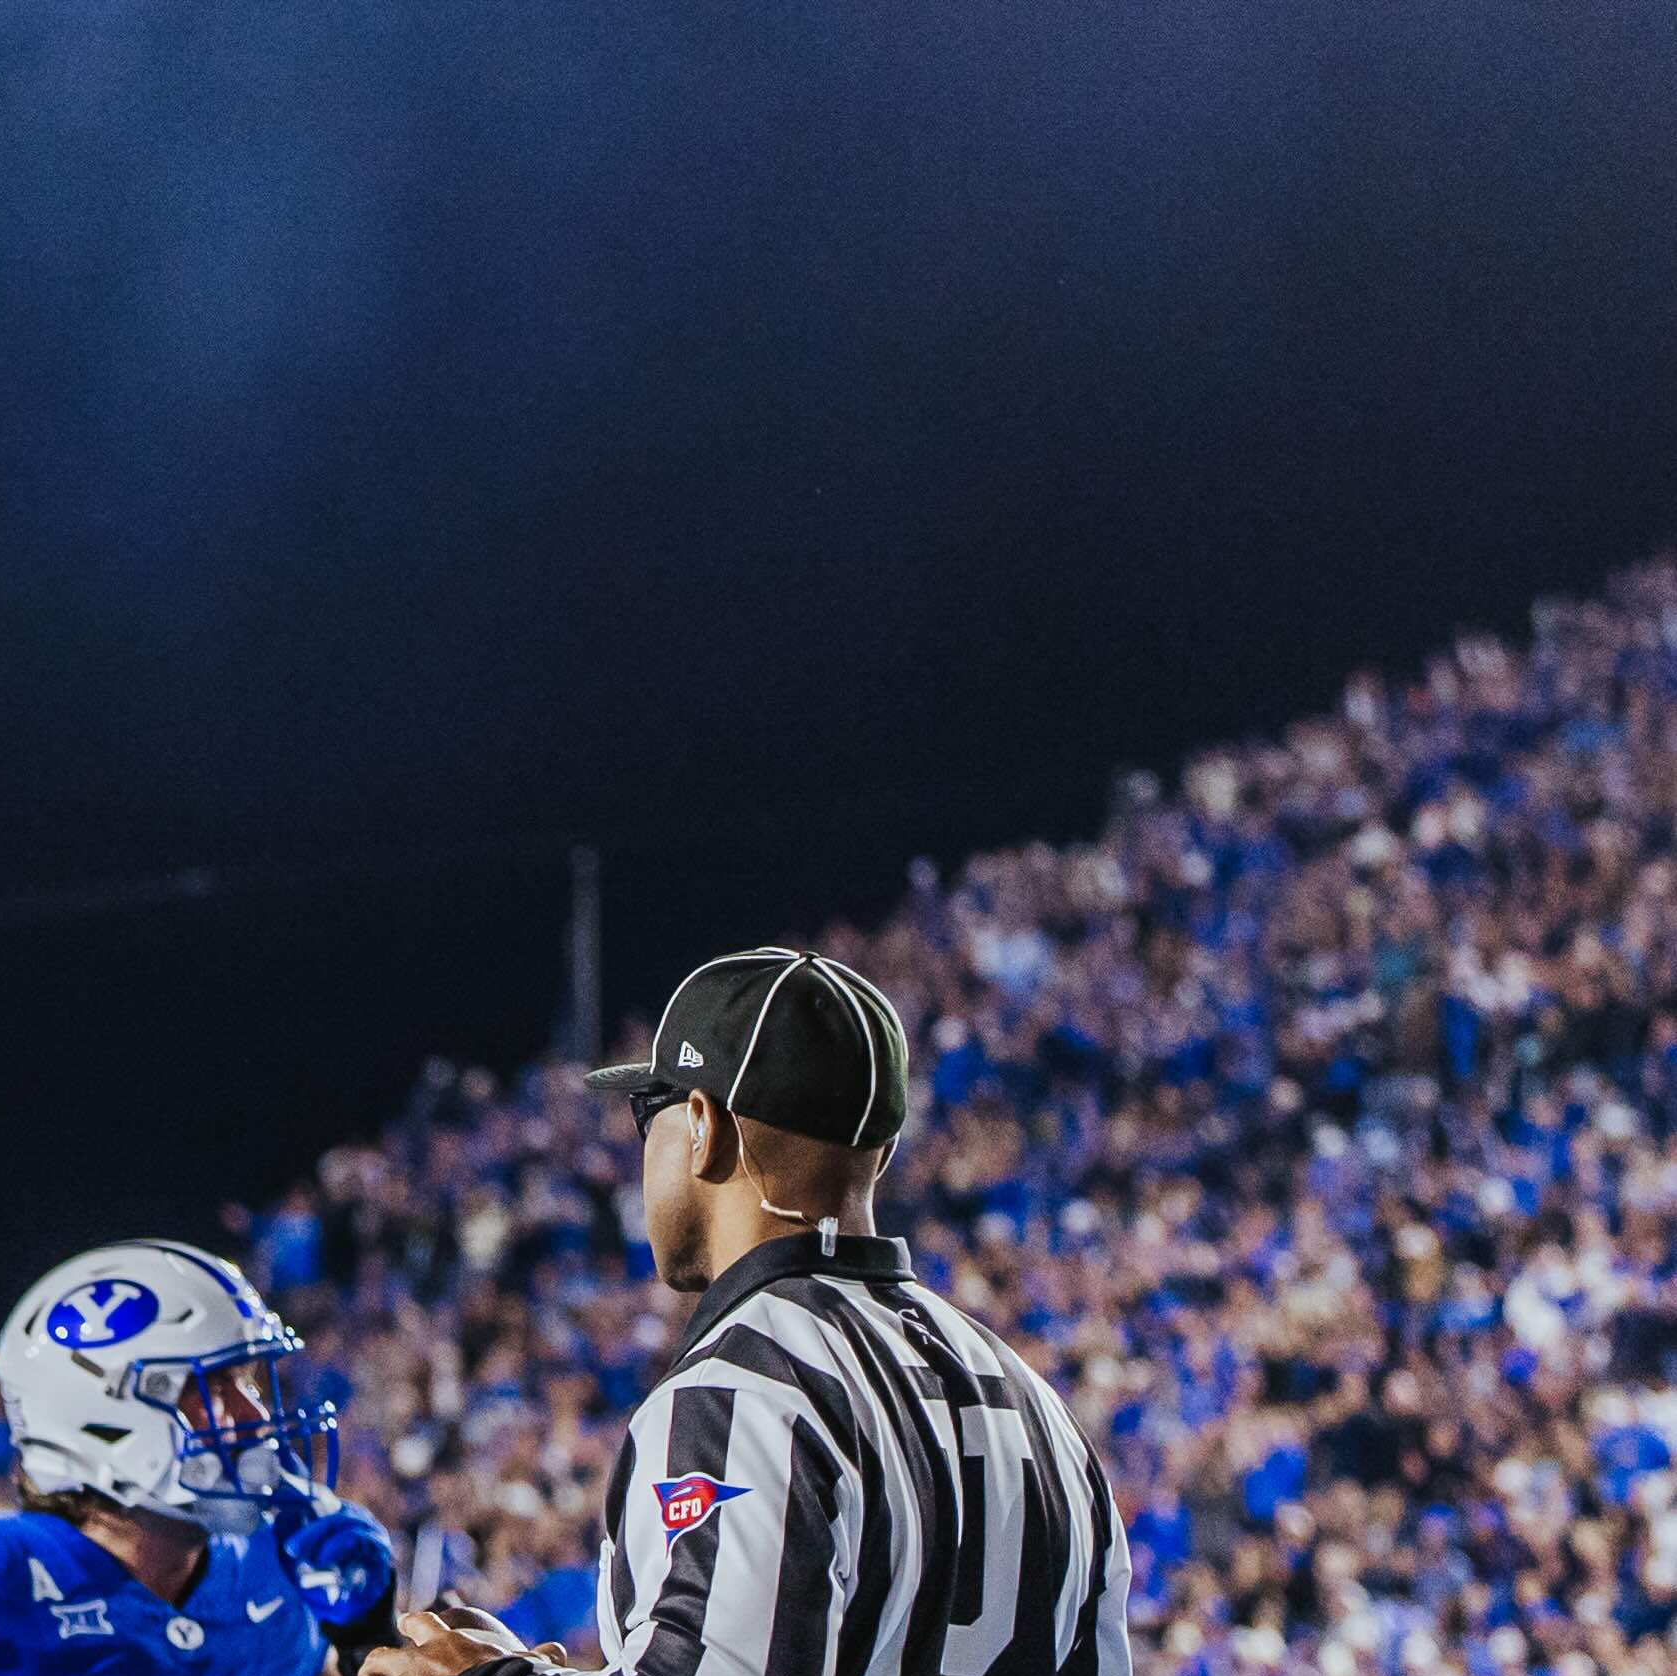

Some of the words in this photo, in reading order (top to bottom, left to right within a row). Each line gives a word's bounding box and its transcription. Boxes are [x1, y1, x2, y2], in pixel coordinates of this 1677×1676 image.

[61, 1282, 142, 1343] Y
[668, 1497, 703, 1522] CFO
[28, 1557, 65, 1602] A
